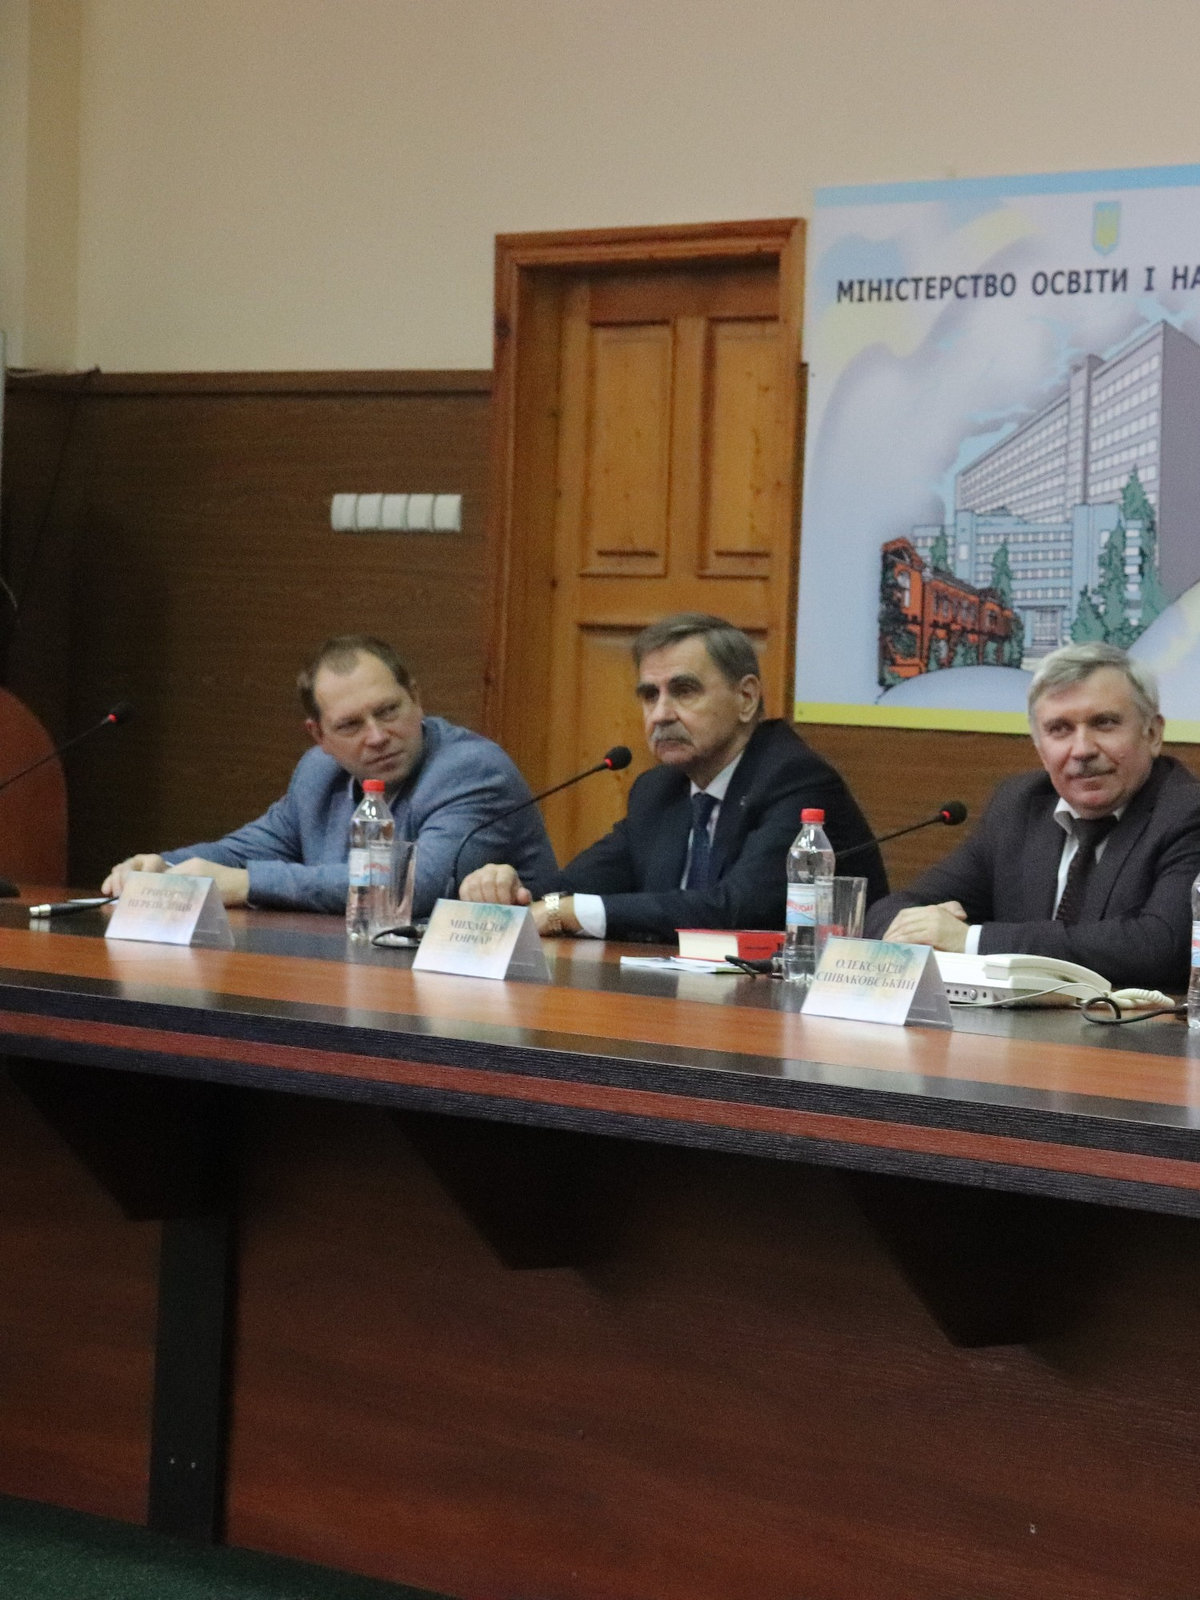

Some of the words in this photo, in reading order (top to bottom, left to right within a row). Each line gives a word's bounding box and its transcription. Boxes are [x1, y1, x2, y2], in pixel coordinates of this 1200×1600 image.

[836, 272, 1017, 304] МІНІСТЕРСТВО
[1031, 268, 1129, 295] ОСВІТИ
[1144, 266, 1155, 292] І
